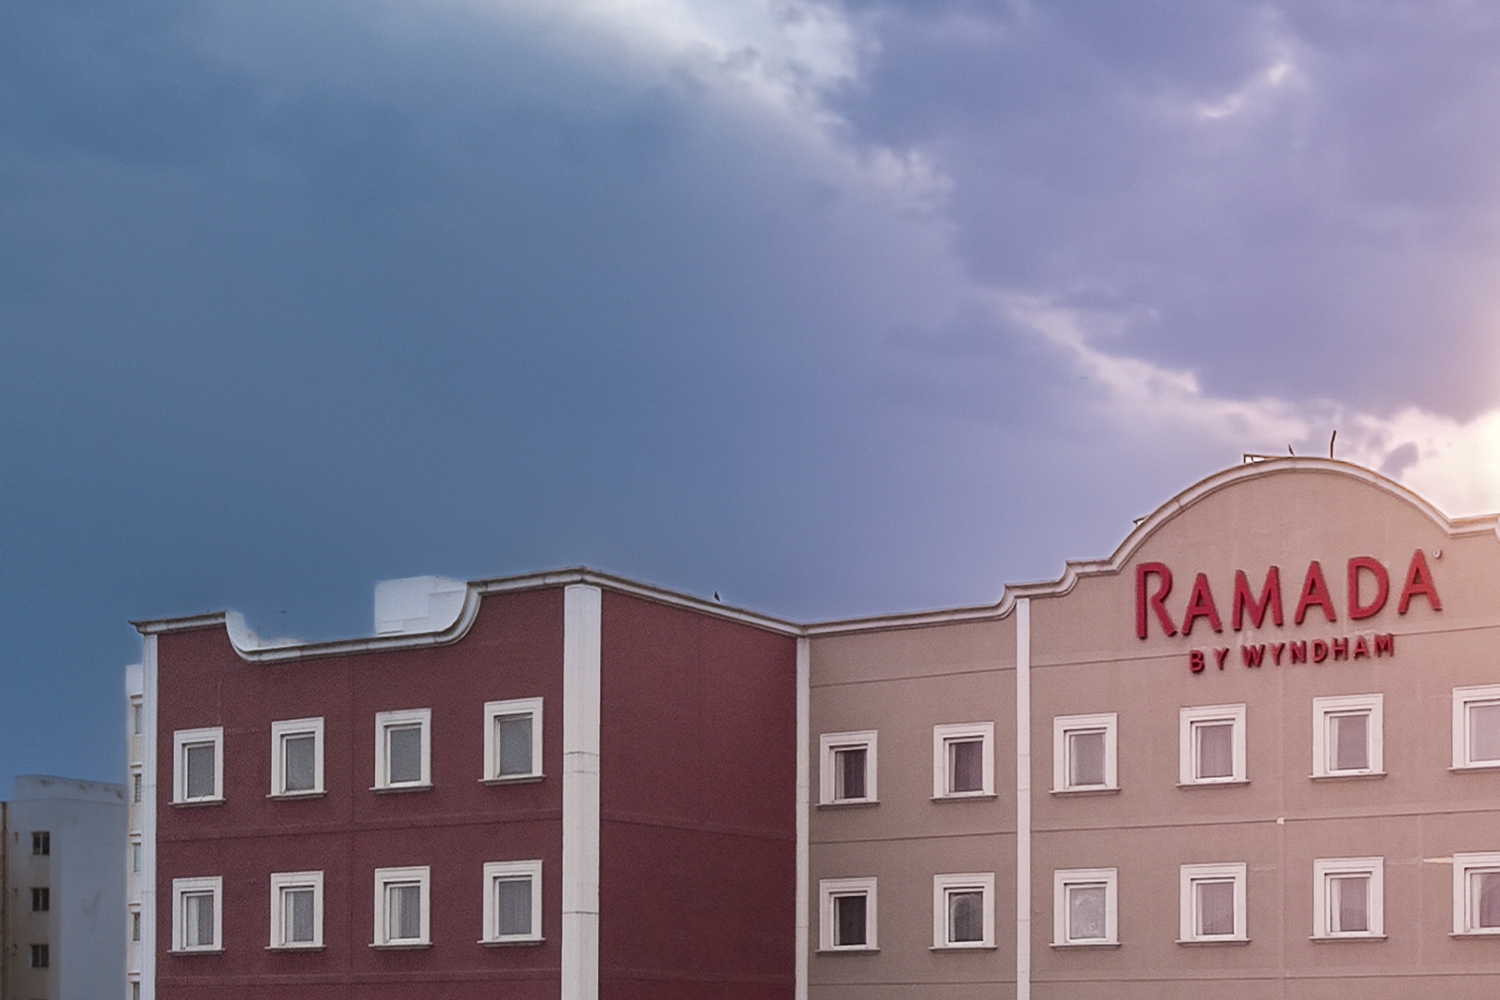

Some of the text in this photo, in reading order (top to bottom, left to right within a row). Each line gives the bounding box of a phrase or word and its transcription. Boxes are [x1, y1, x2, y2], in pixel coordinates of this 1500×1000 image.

[1135, 548, 1443, 640] RAMADA
[1188, 633, 1395, 673] BY WYNDHAM
